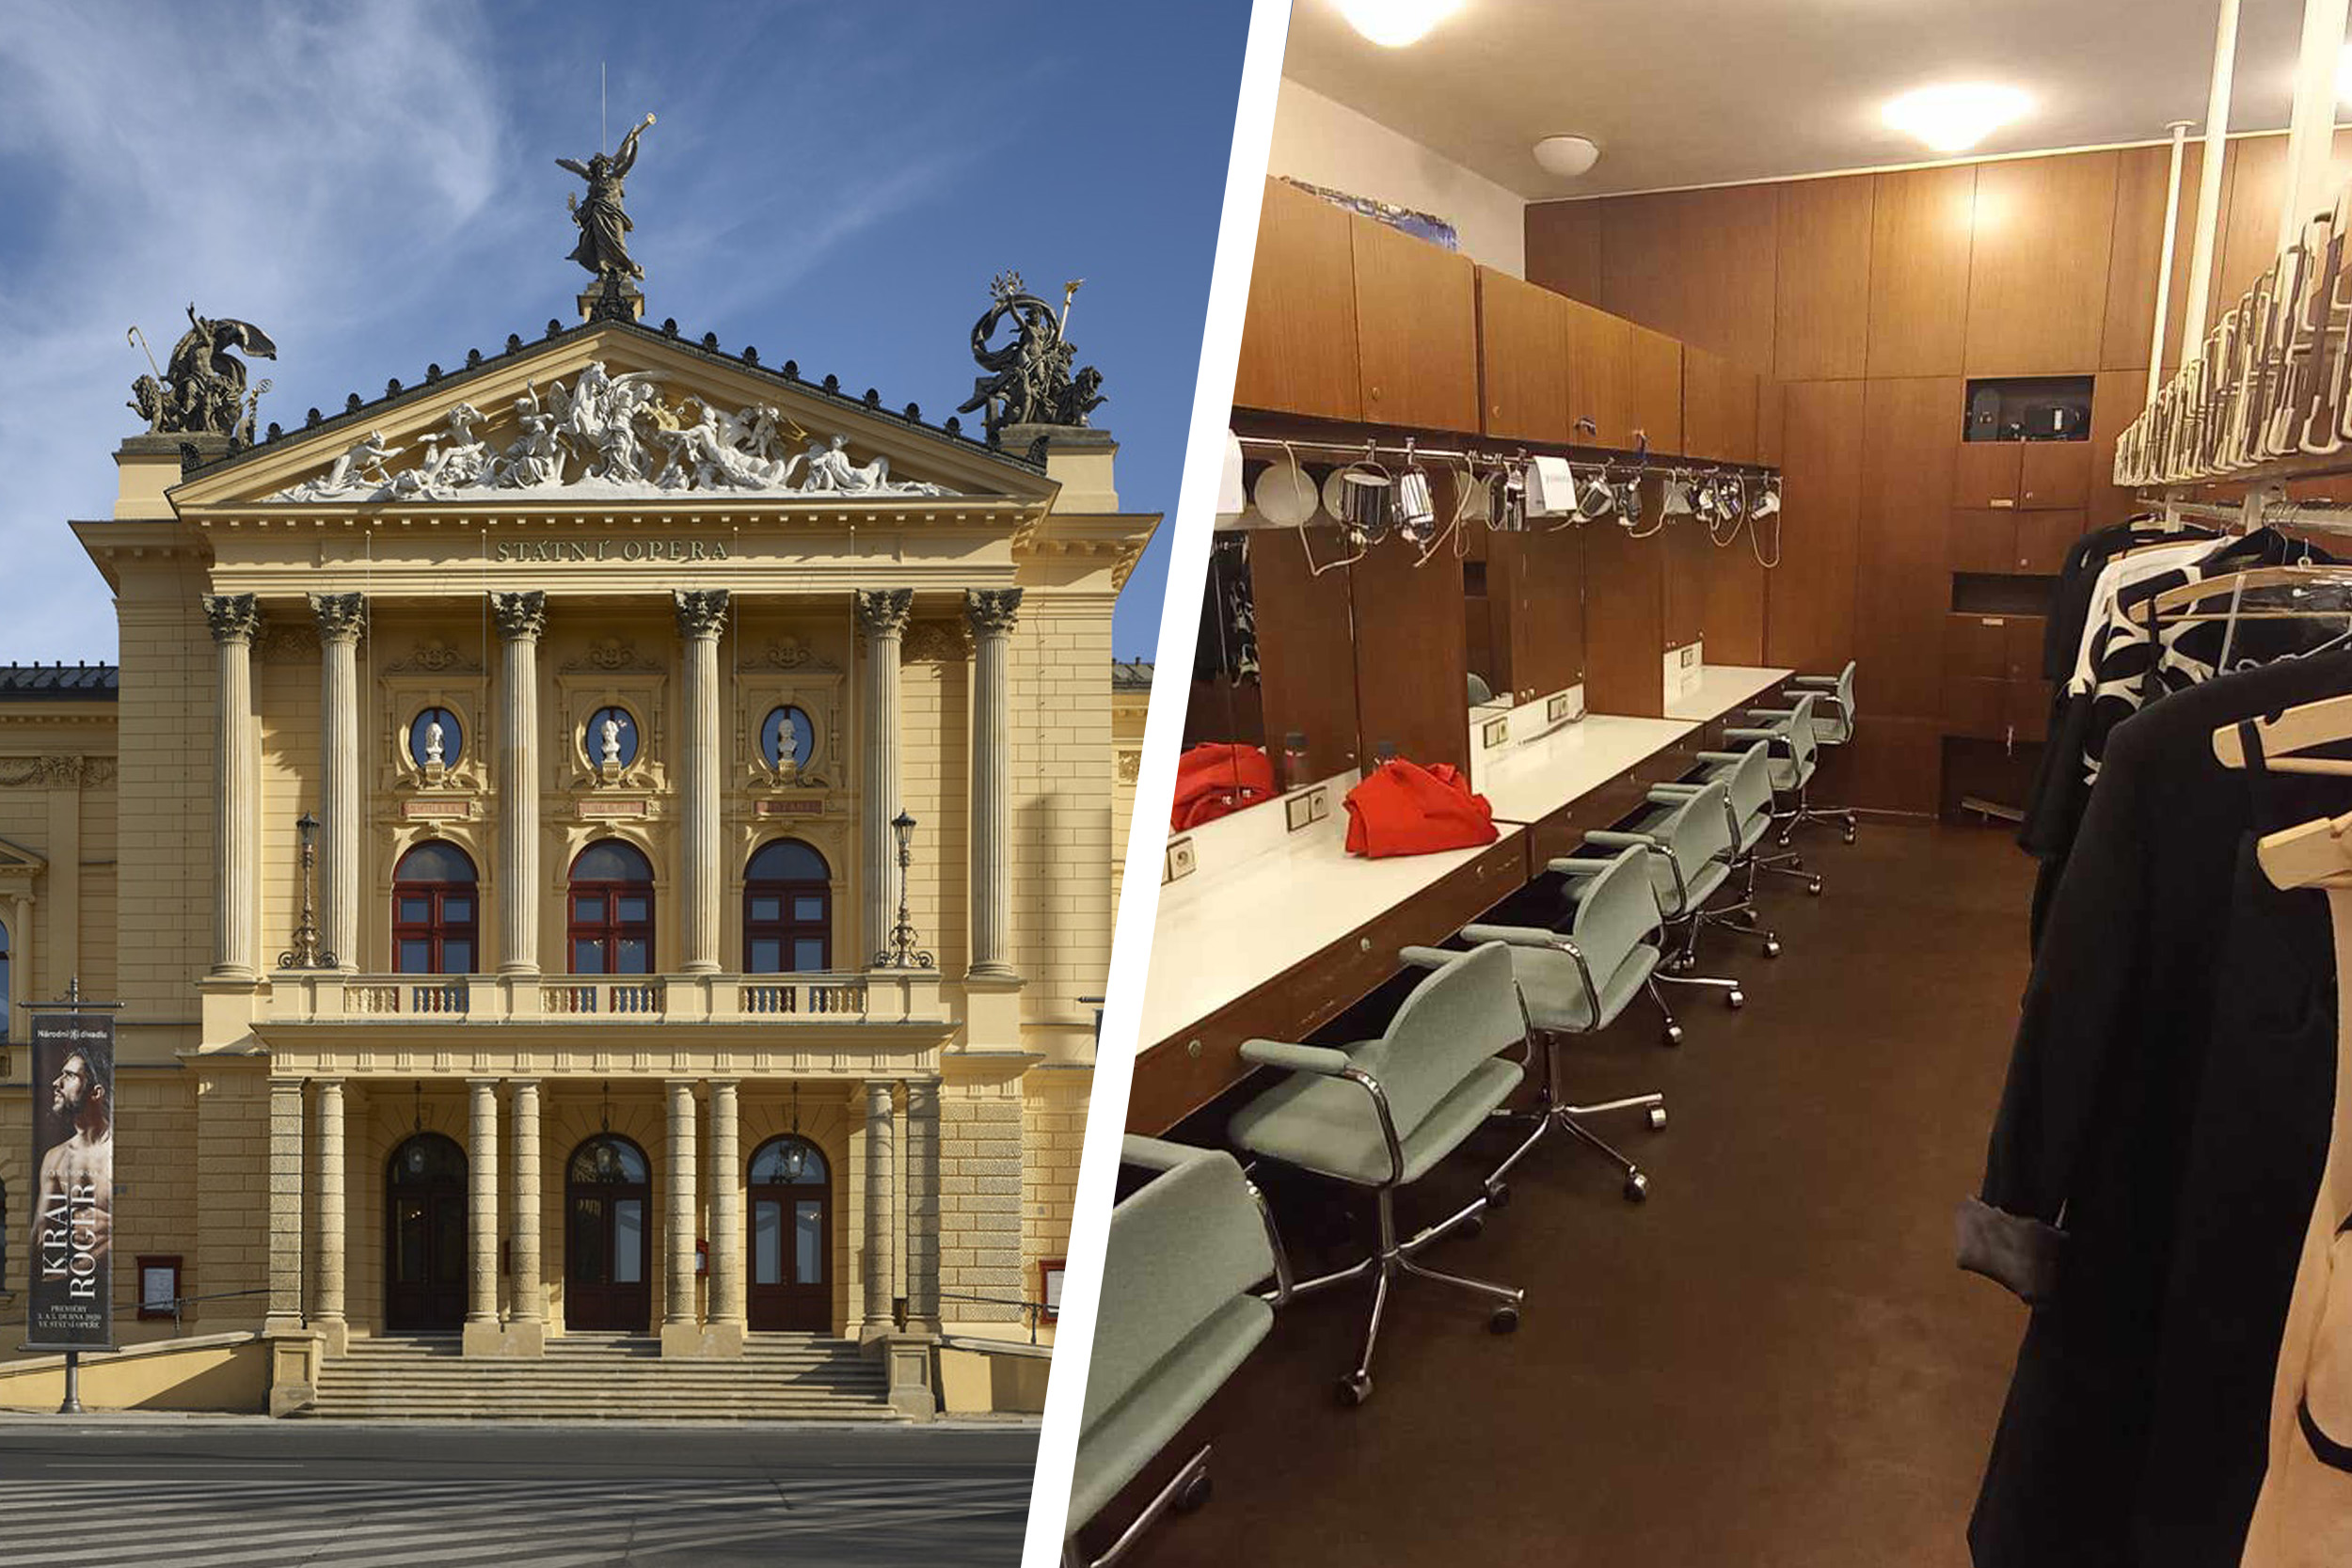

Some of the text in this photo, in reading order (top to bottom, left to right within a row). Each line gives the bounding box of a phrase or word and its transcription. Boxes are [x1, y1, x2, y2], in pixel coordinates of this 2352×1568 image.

[497, 540, 728, 562] STÁTNÍ OPERA
[70, 1183, 96, 1300] ROGER
